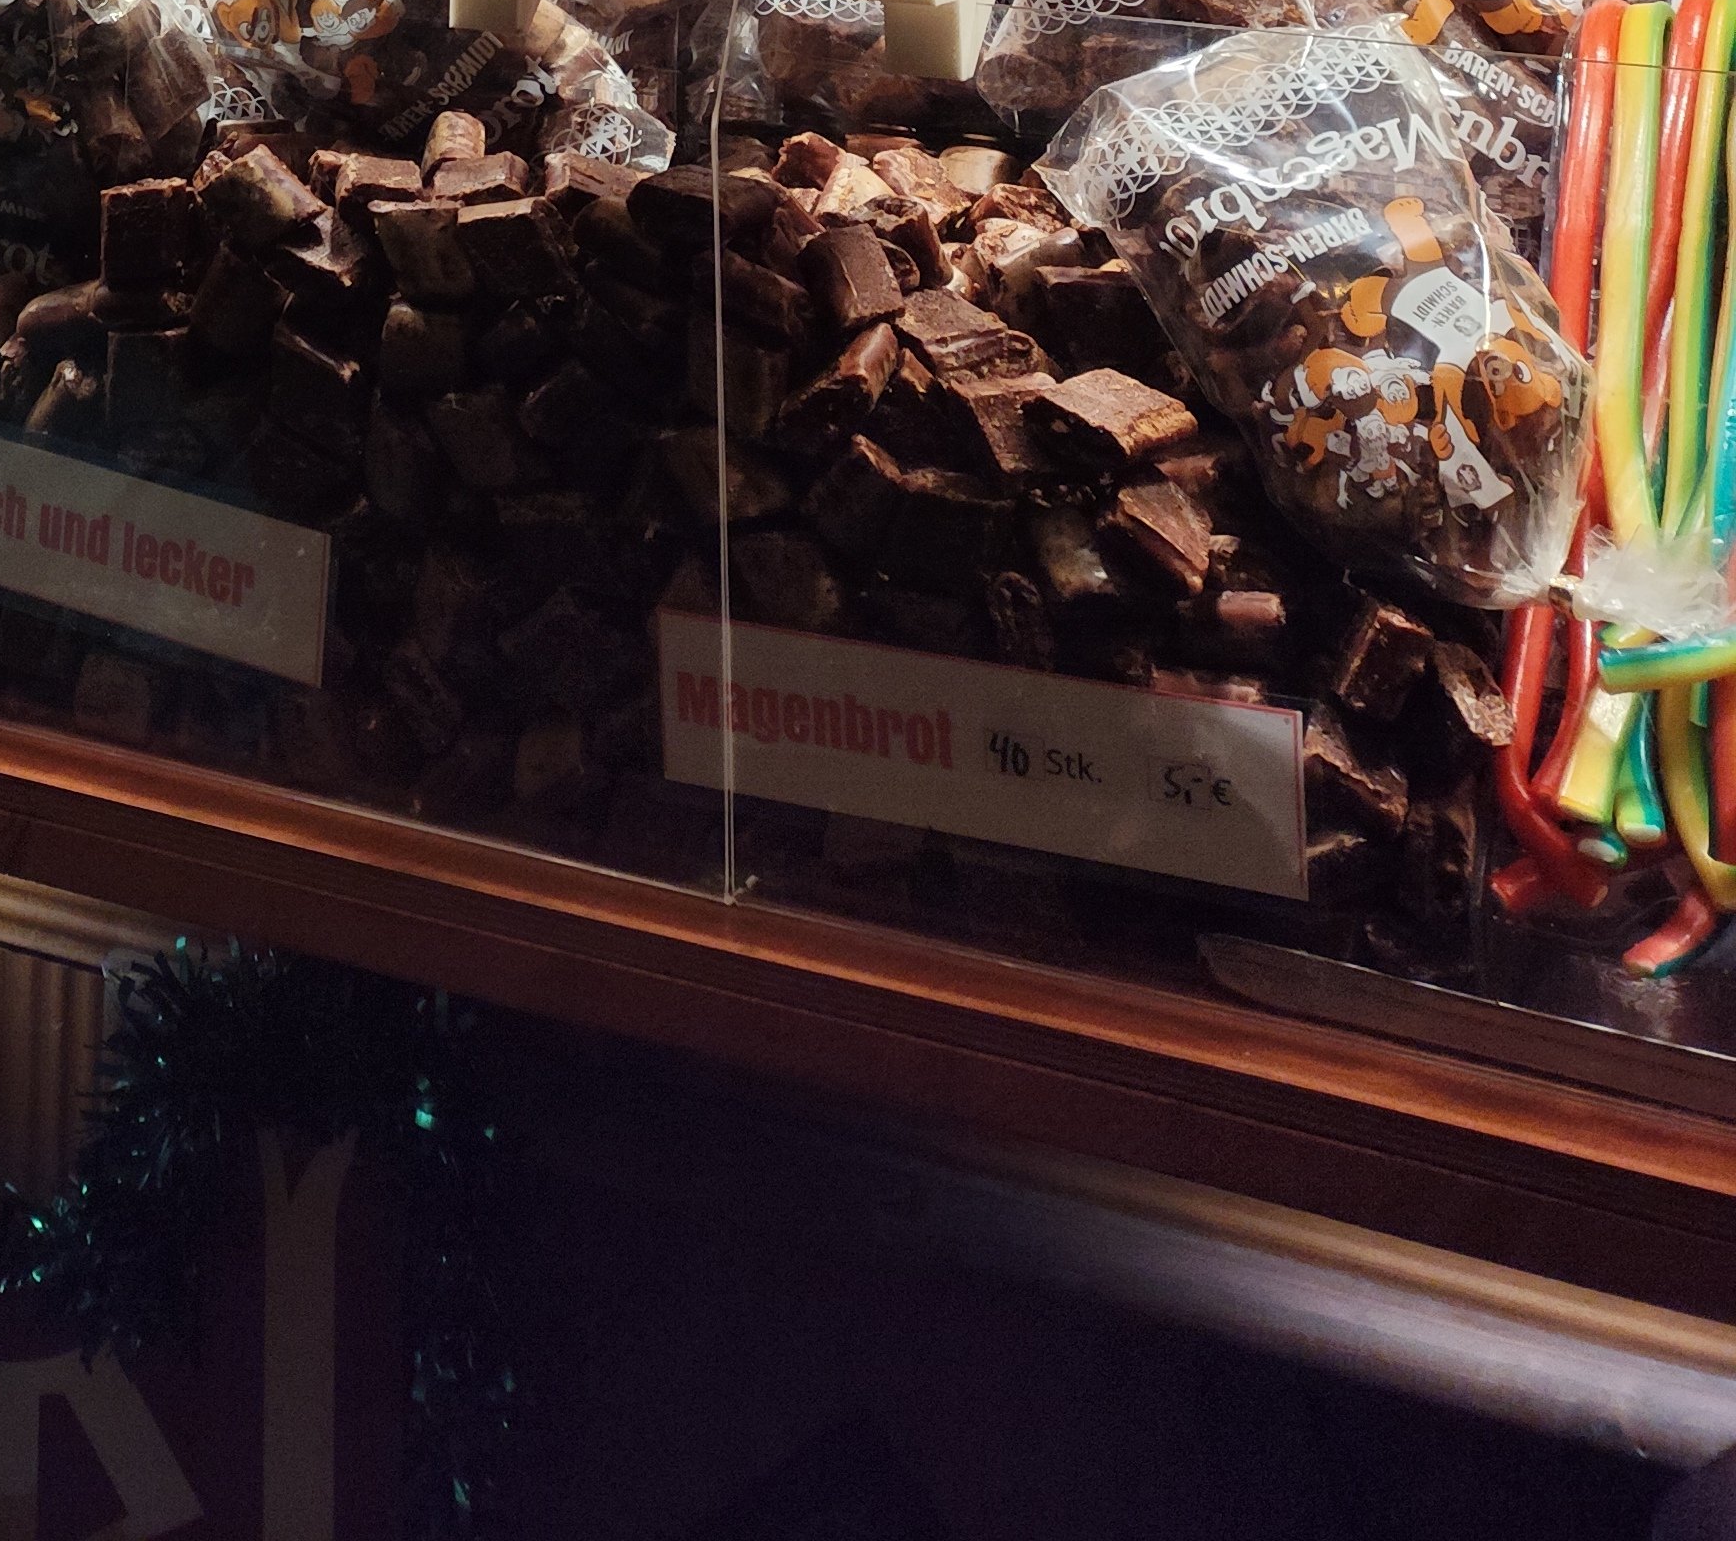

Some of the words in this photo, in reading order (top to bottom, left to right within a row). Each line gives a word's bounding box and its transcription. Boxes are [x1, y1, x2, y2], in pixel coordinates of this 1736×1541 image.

[1412, 281, 1458, 322] SCHMIDT
[39, 502, 111, 567] und
[122, 521, 255, 609] lecker
[676, 672, 953, 770] Magenbrot
[989, 732, 1029, 777] 40
[1045, 750, 1103, 784] Stk.
